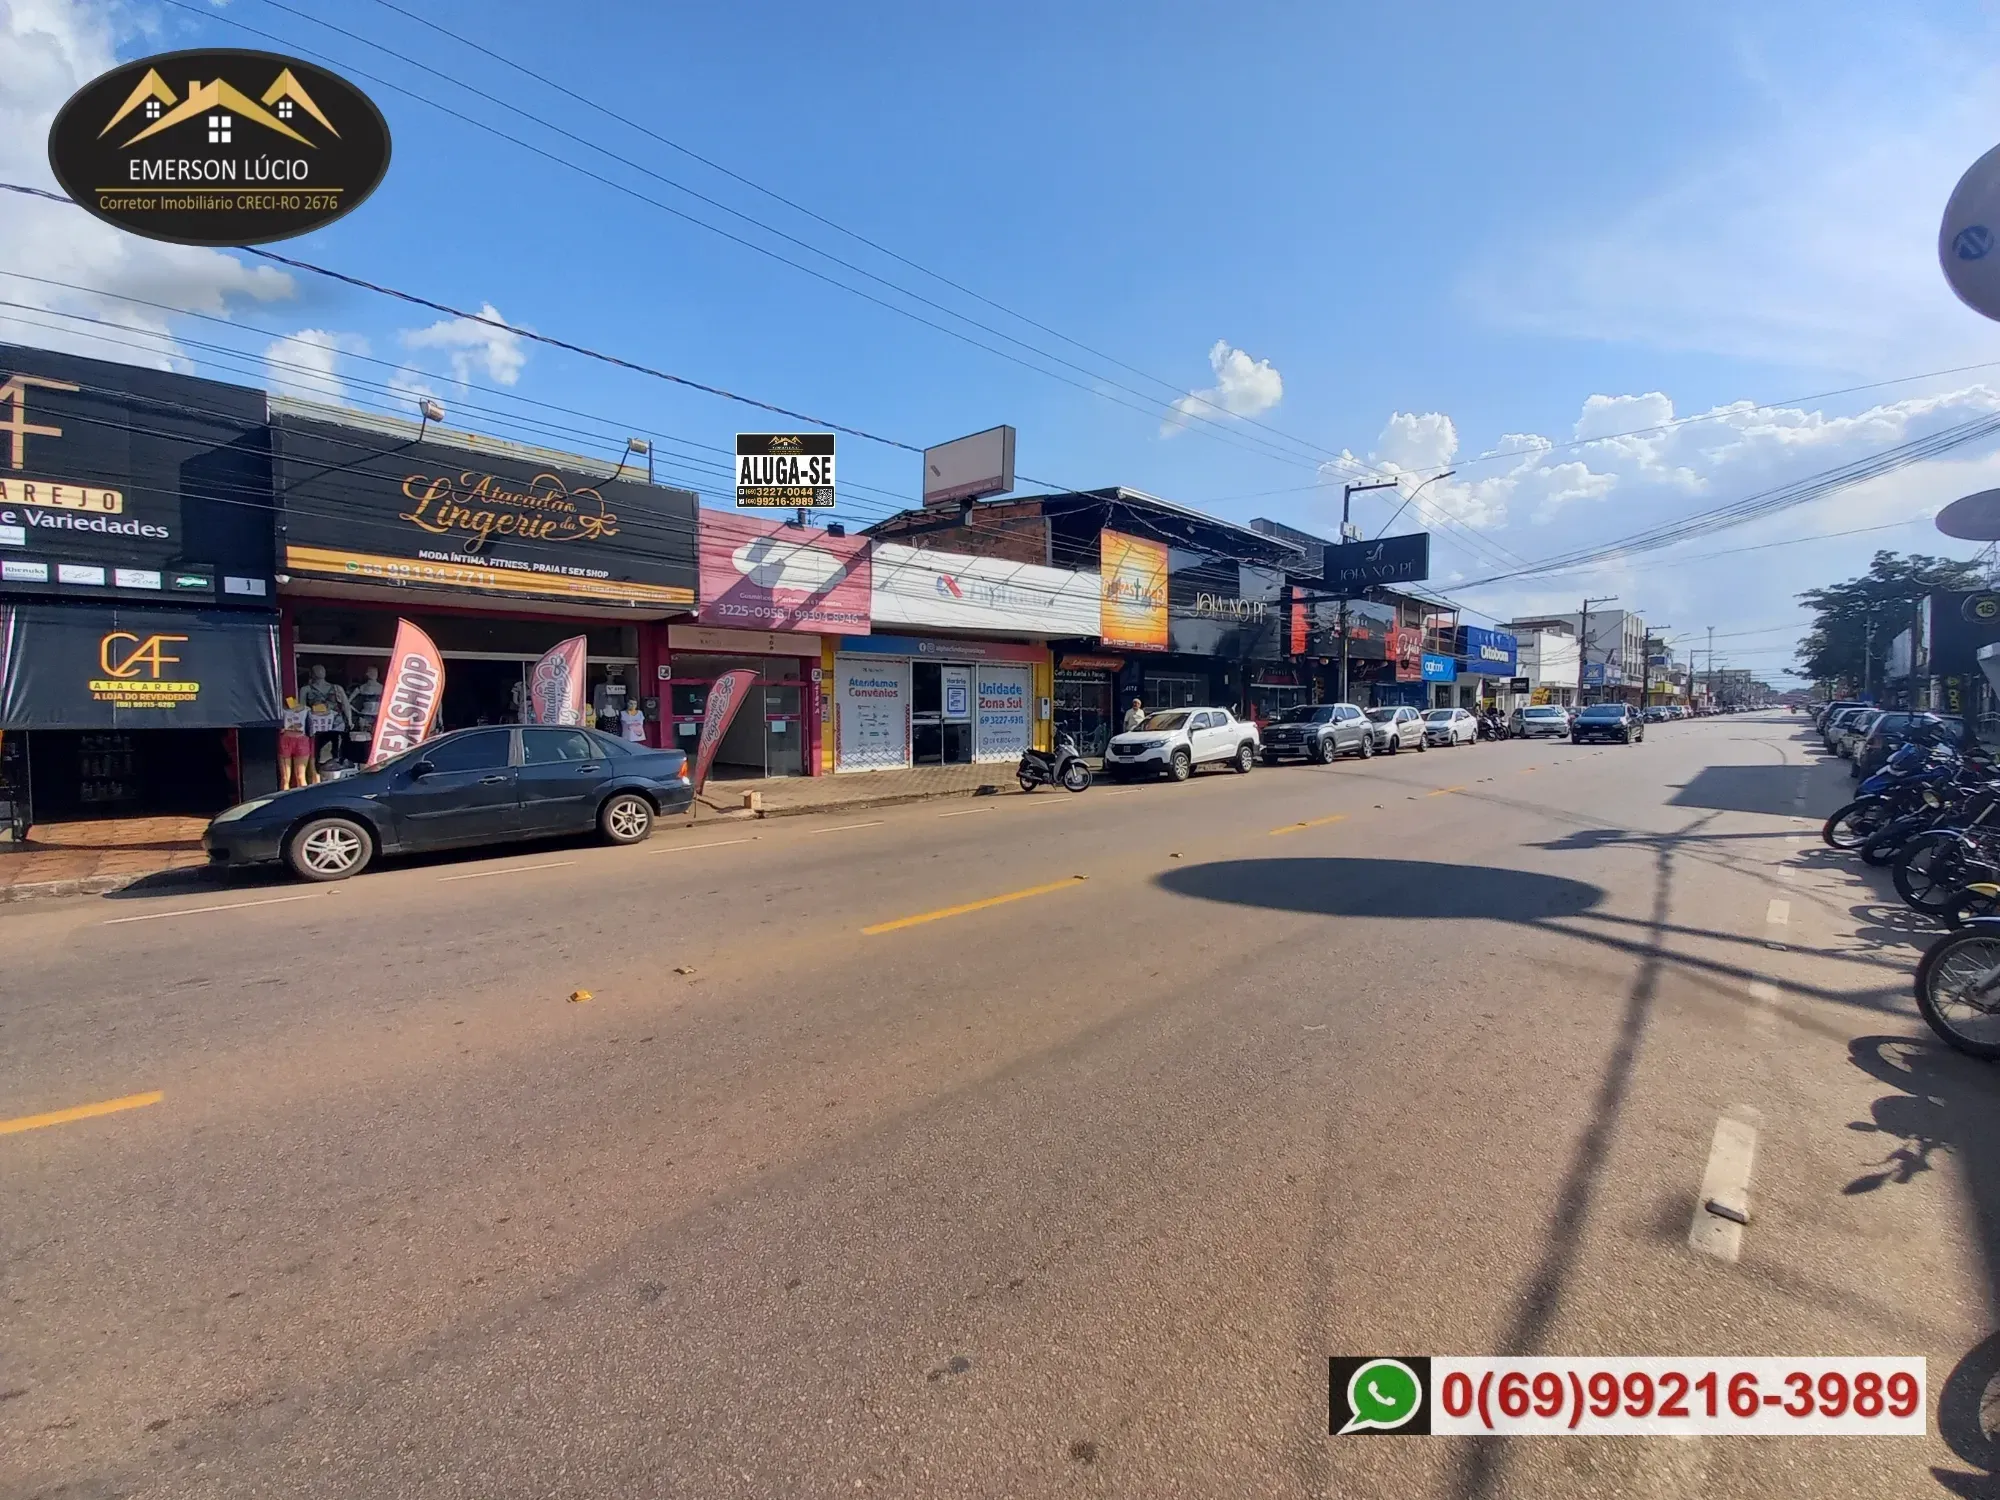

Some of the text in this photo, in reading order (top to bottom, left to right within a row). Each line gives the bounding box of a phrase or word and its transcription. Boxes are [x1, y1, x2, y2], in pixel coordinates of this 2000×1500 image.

[452, 470, 577, 514] Atacadão
[399, 473, 558, 554] Lingerie
[23, 508, 170, 539] Variedades
[418, 549, 609, 579] MODA ÍNTIMA, FITNESS, PRAIA E SEX SHOP
[1372, 563, 1395, 577] NO
[719, 603, 785, 619] 3225-0958
[794, 609, 859, 624] 99394-8946
[1188, 591, 1225, 620] JOIA
[1229, 597, 1250, 623] NO
[1253, 595, 1268, 625] PÉ
[1480, 645, 1509, 662] Ortobom
[94, 682, 196, 692] ATACAREJO
[390, 656, 437, 723] SHOP
[848, 677, 898, 688] Atendemos
[978, 682, 1023, 695] Unidade
[94, 693, 197, 701] A LOJA DO REVENDEDOR
[848, 687, 898, 698] Convênios
[979, 697, 1022, 709] Zona Sul
